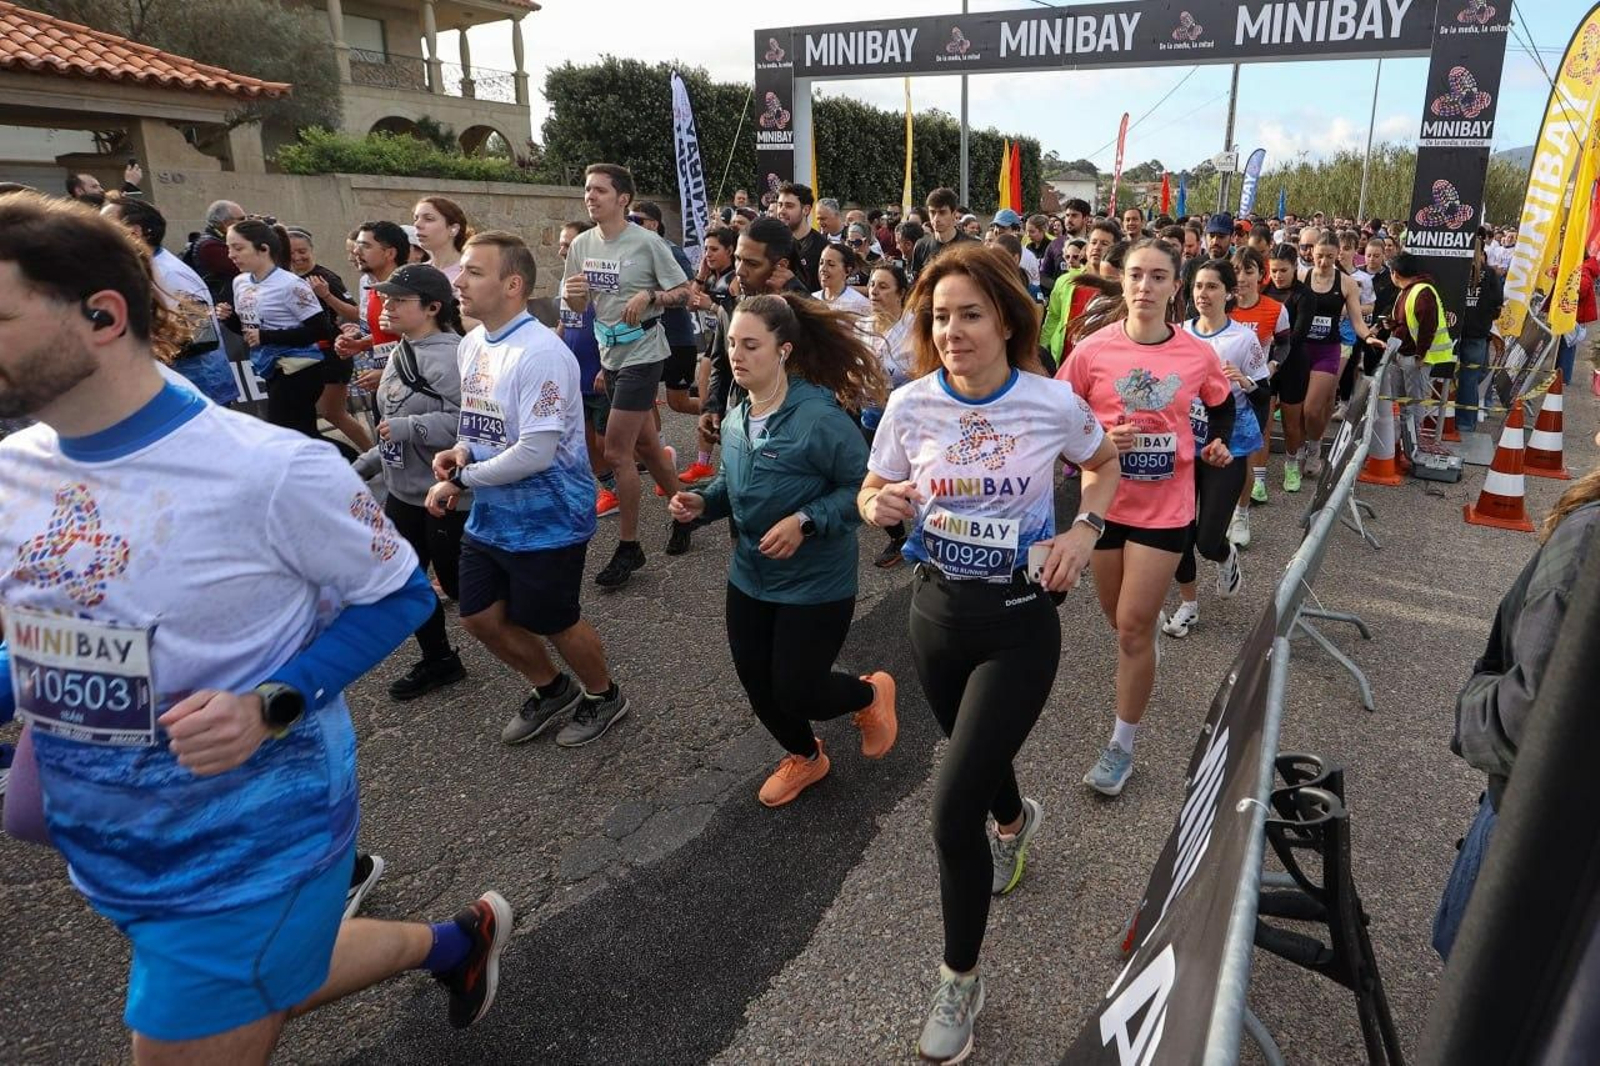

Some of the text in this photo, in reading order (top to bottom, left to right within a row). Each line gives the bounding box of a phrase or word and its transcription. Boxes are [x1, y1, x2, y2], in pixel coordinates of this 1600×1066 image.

[1235, 0, 1413, 46] MINIBAY
[1000, 12, 1142, 58] MINIBAY
[805, 28, 918, 67] MINIBAY
[757, 131, 792, 143] MINIBAY
[1422, 121, 1492, 137] MINIBAY
[1504, 83, 1588, 304] MINIBAY
[1407, 231, 1475, 247] MINIBAY
[585, 261, 617, 270] MINIBAY
[588, 273, 615, 284] 11453
[466, 397, 501, 414] MINIBAY
[471, 415, 502, 434] 11243
[1120, 453, 1169, 468] 10950
[930, 477, 1031, 497] MINIBAY
[930, 515, 1010, 540] MINIBAY
[935, 541, 1003, 568] 10920
[15, 621, 134, 664] MINIBAY
[30, 666, 132, 712] 10503
